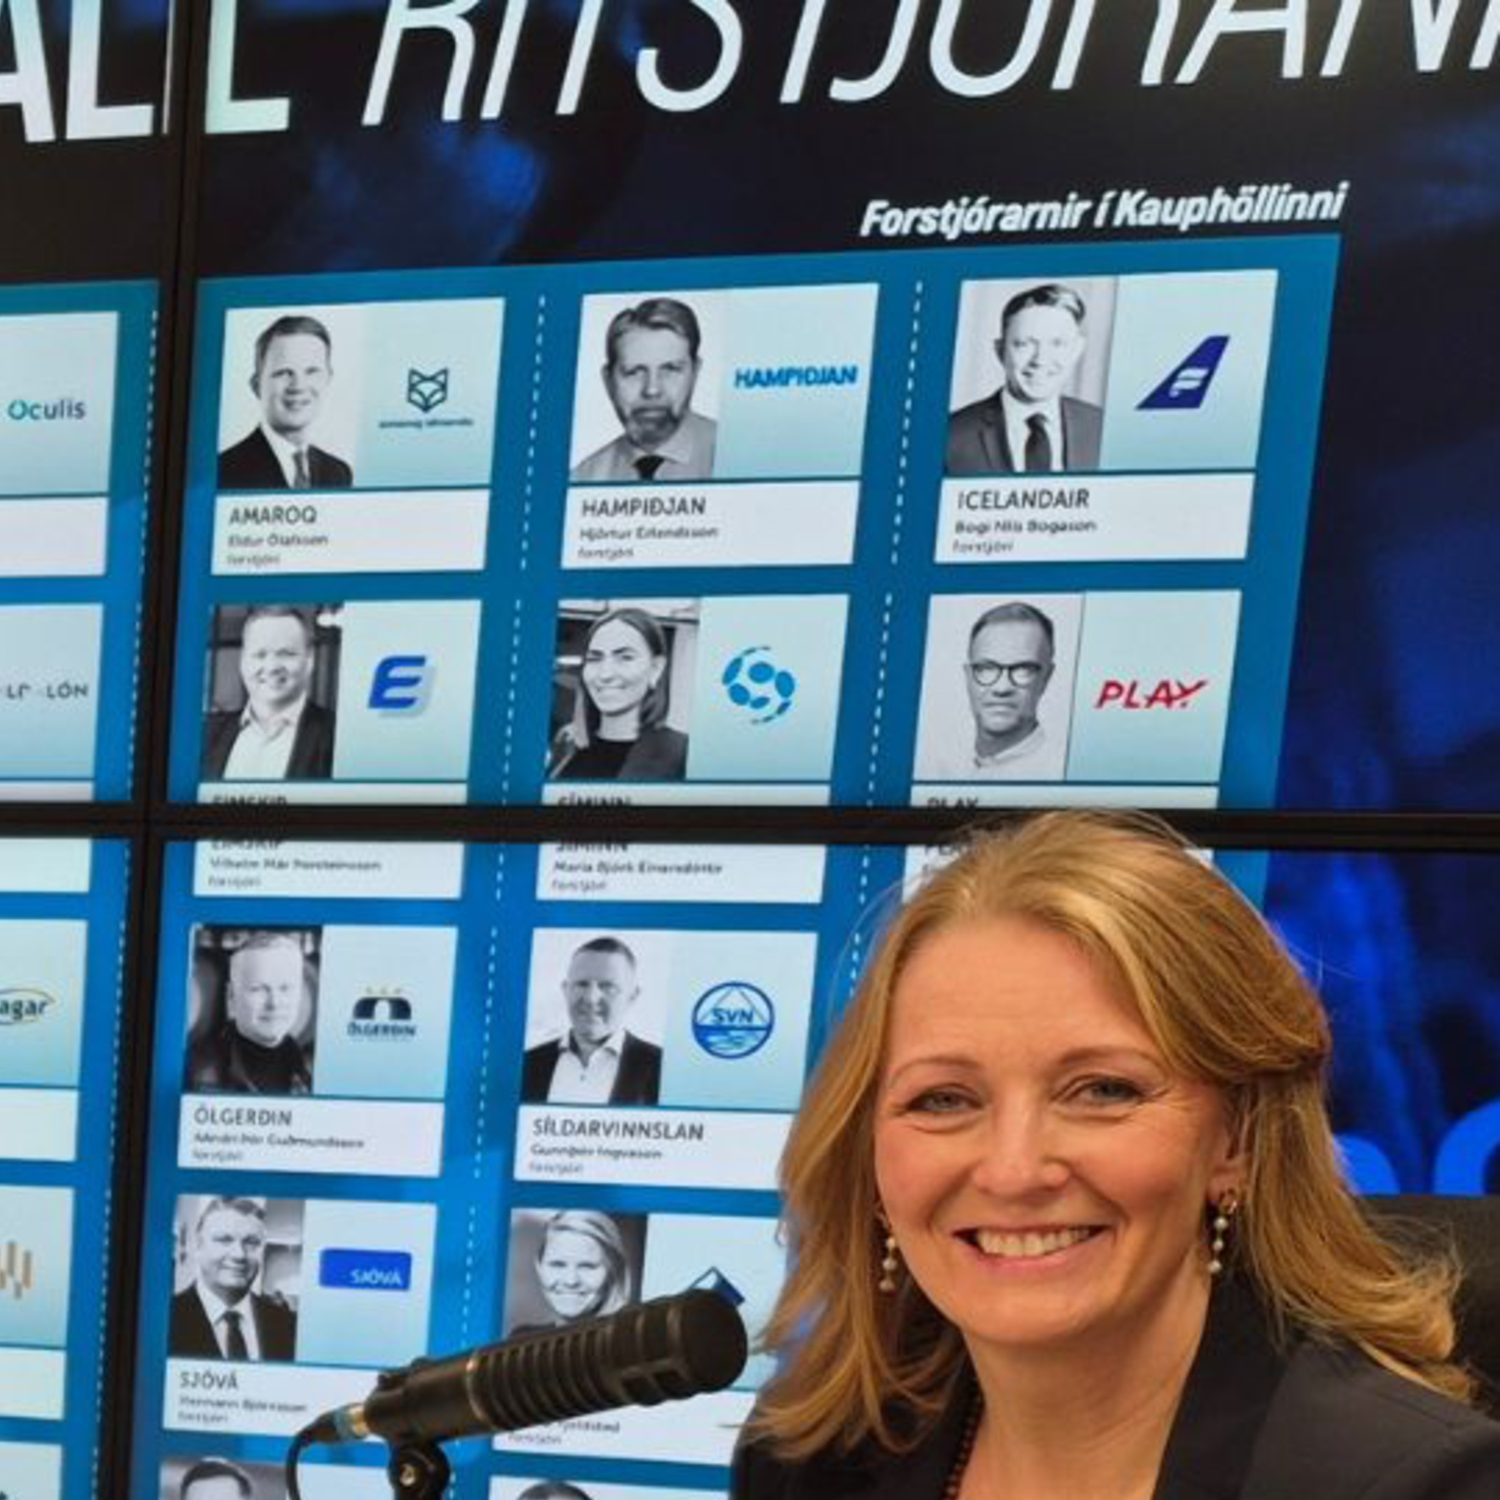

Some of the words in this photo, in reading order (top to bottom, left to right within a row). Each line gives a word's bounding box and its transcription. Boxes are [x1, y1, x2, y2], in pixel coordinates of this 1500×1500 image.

[860, 193, 1092, 239] Forstjórarnir
[1095, 191, 1115, 226] í
[1114, 182, 1349, 232] Kauphöllinni
[7, 399, 86, 421] Oculis
[957, 488, 1090, 511] ICELANDAIR
[229, 505, 318, 525] AMAROQ
[1093, 678, 1209, 711] PLAY
[711, 1007, 755, 1025] SVN
[194, 1106, 293, 1126] ÖLGERÐIN
[532, 1115, 706, 1142] SÍLDARVINNSLAN
[179, 1368, 240, 1390] SJÓVÁ
